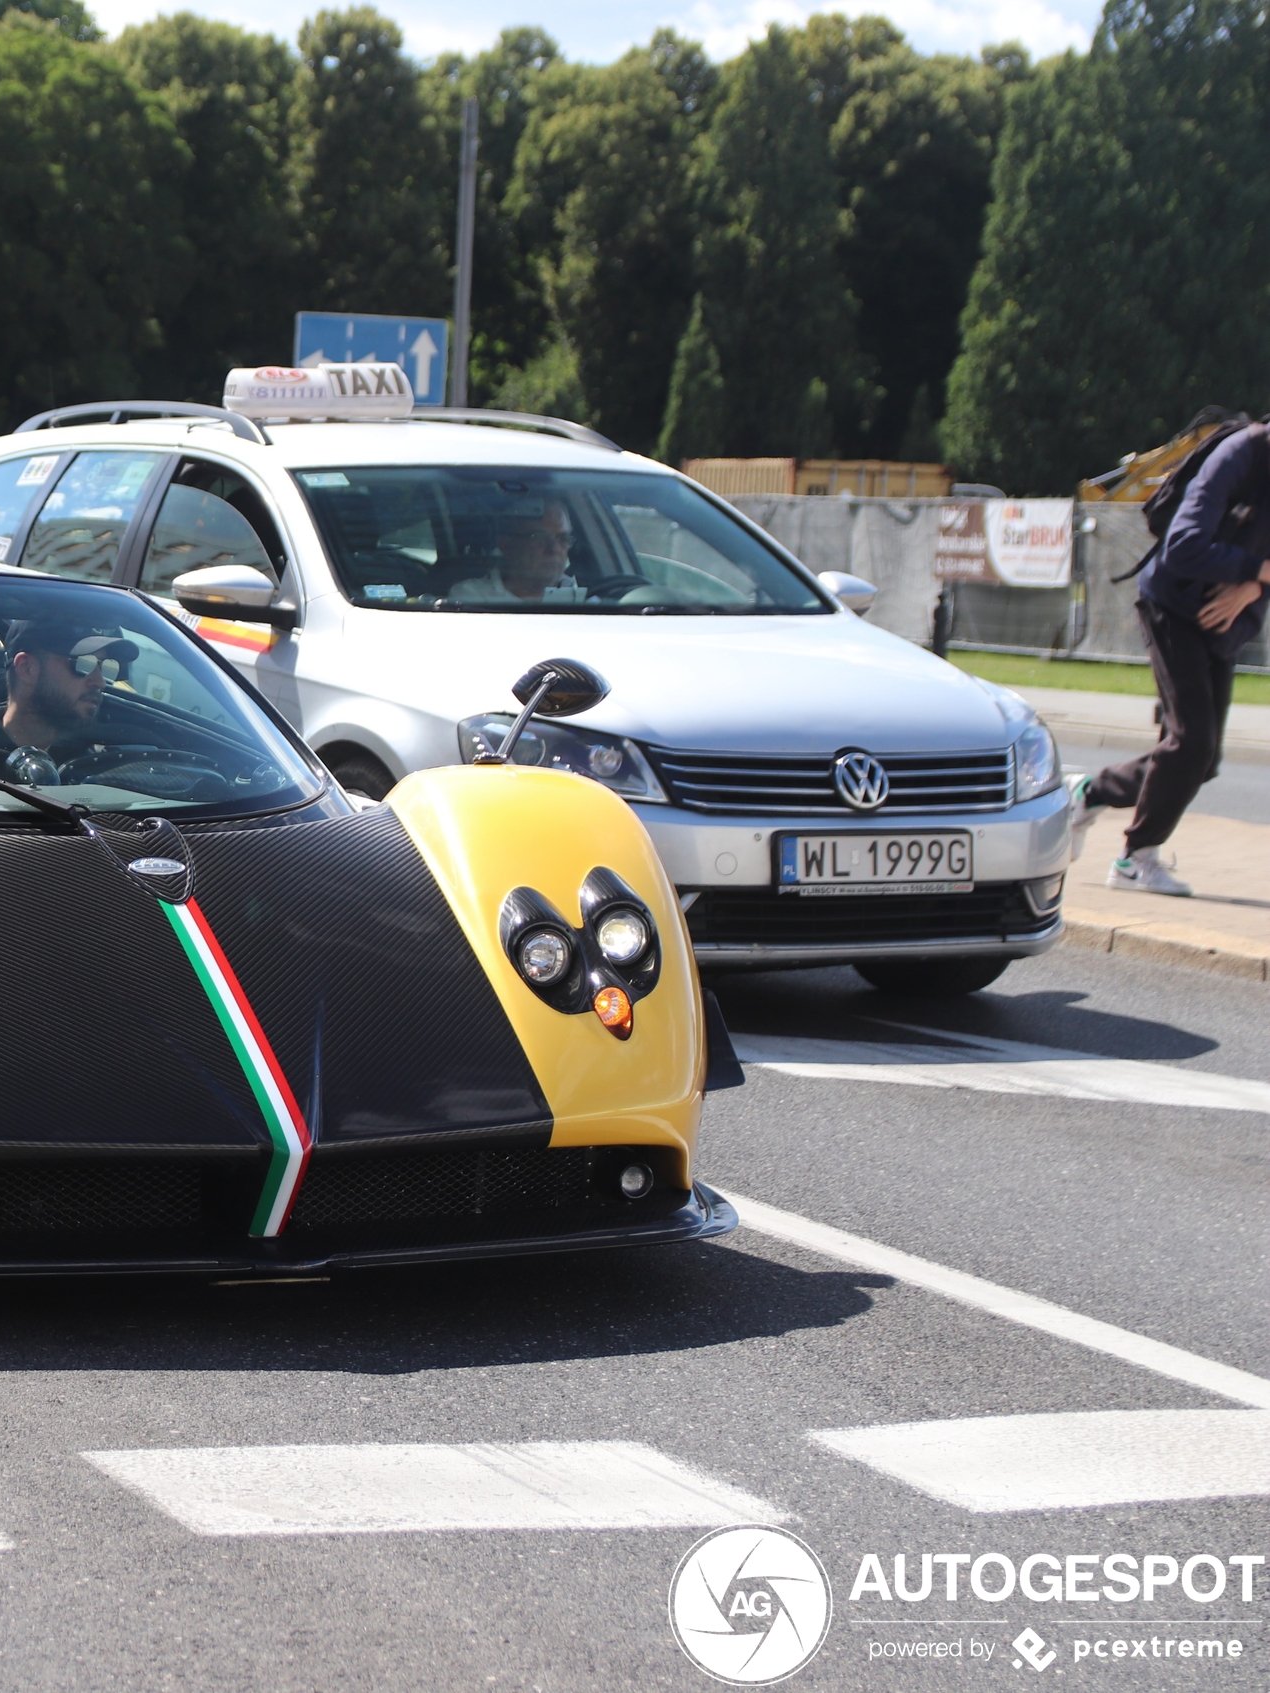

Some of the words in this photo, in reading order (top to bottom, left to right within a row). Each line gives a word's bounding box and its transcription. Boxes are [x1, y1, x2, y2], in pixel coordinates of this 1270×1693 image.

[327, 367, 407, 396] TAXI
[784, 865, 796, 875] PL
[804, 840, 850, 877] WL
[867, 838, 966, 877] 1999G
